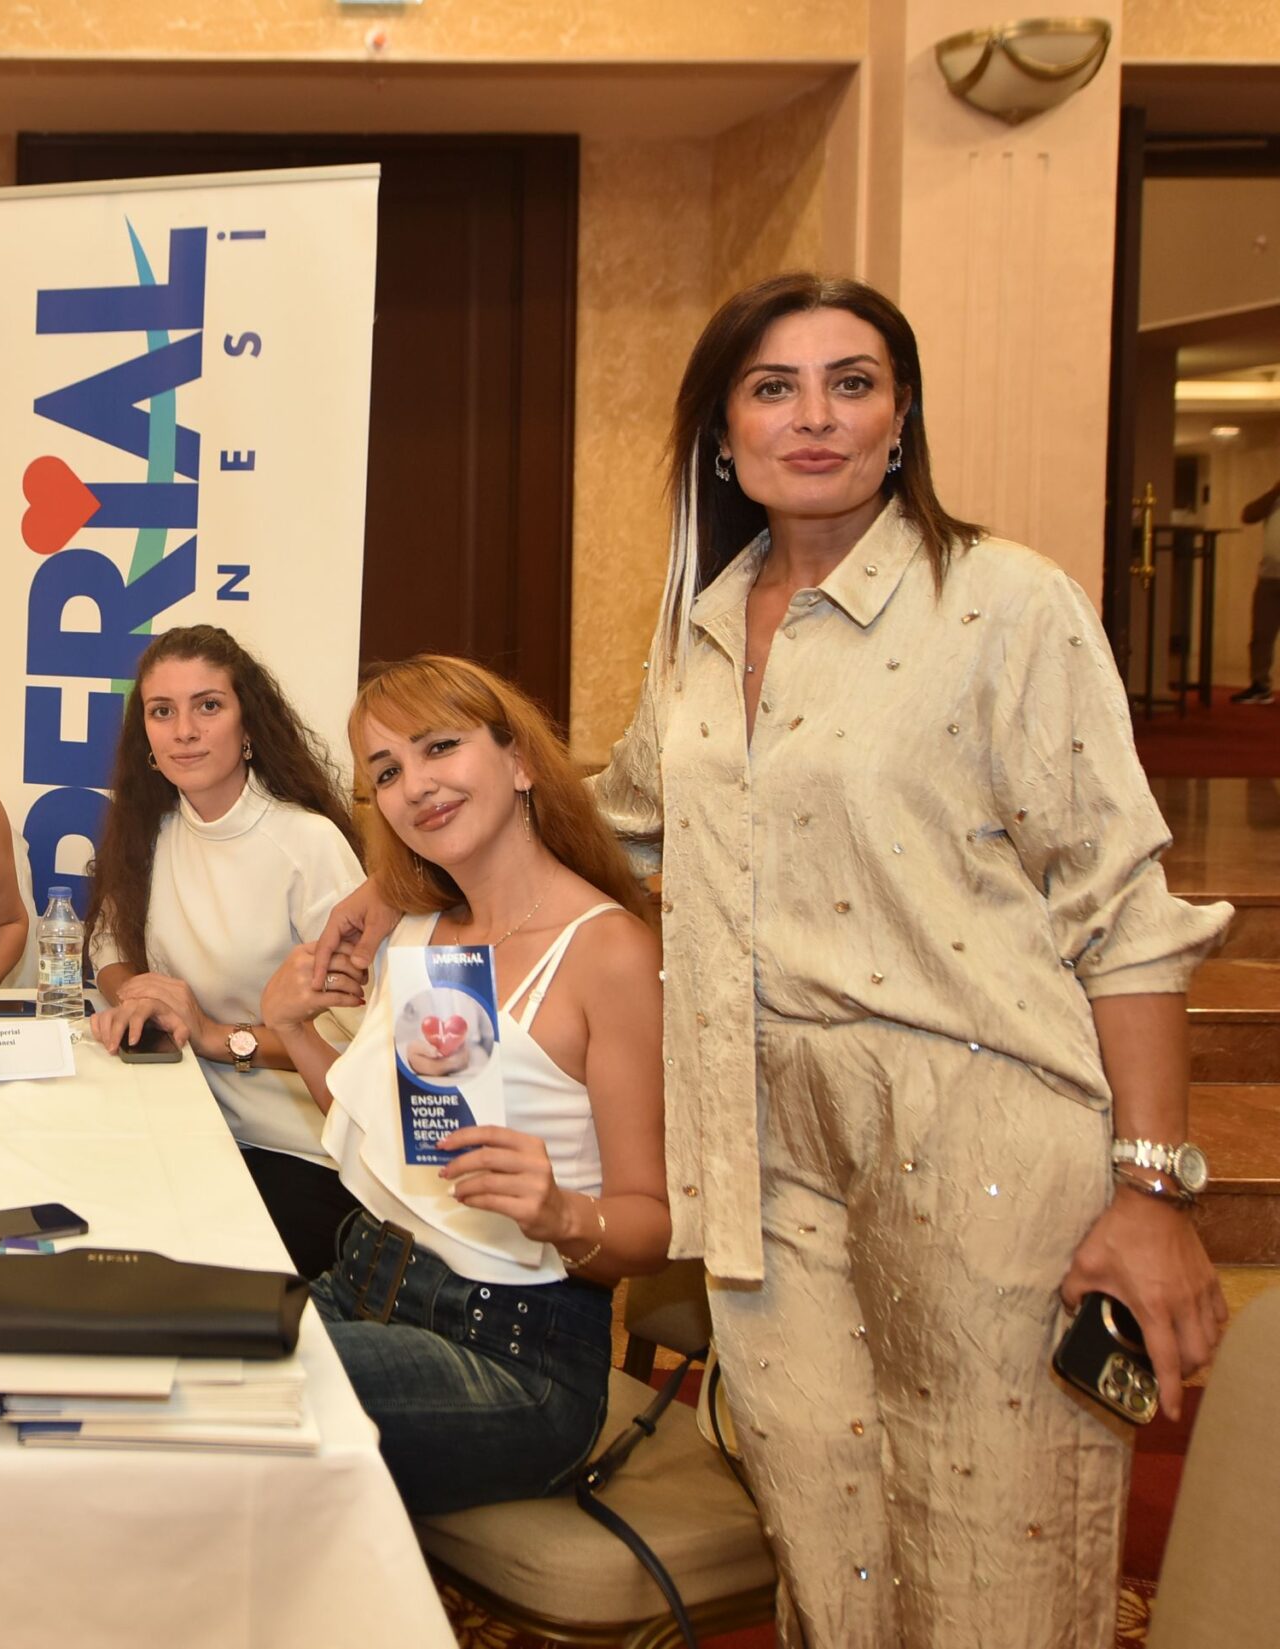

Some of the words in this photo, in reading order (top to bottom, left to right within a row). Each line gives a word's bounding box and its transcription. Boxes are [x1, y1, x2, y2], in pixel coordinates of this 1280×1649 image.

[22, 226, 208, 918] PERIAL
[410, 1095, 459, 1106] ENSURE
[411, 1106, 445, 1117] YOUR
[413, 1119, 459, 1130] HEALTH
